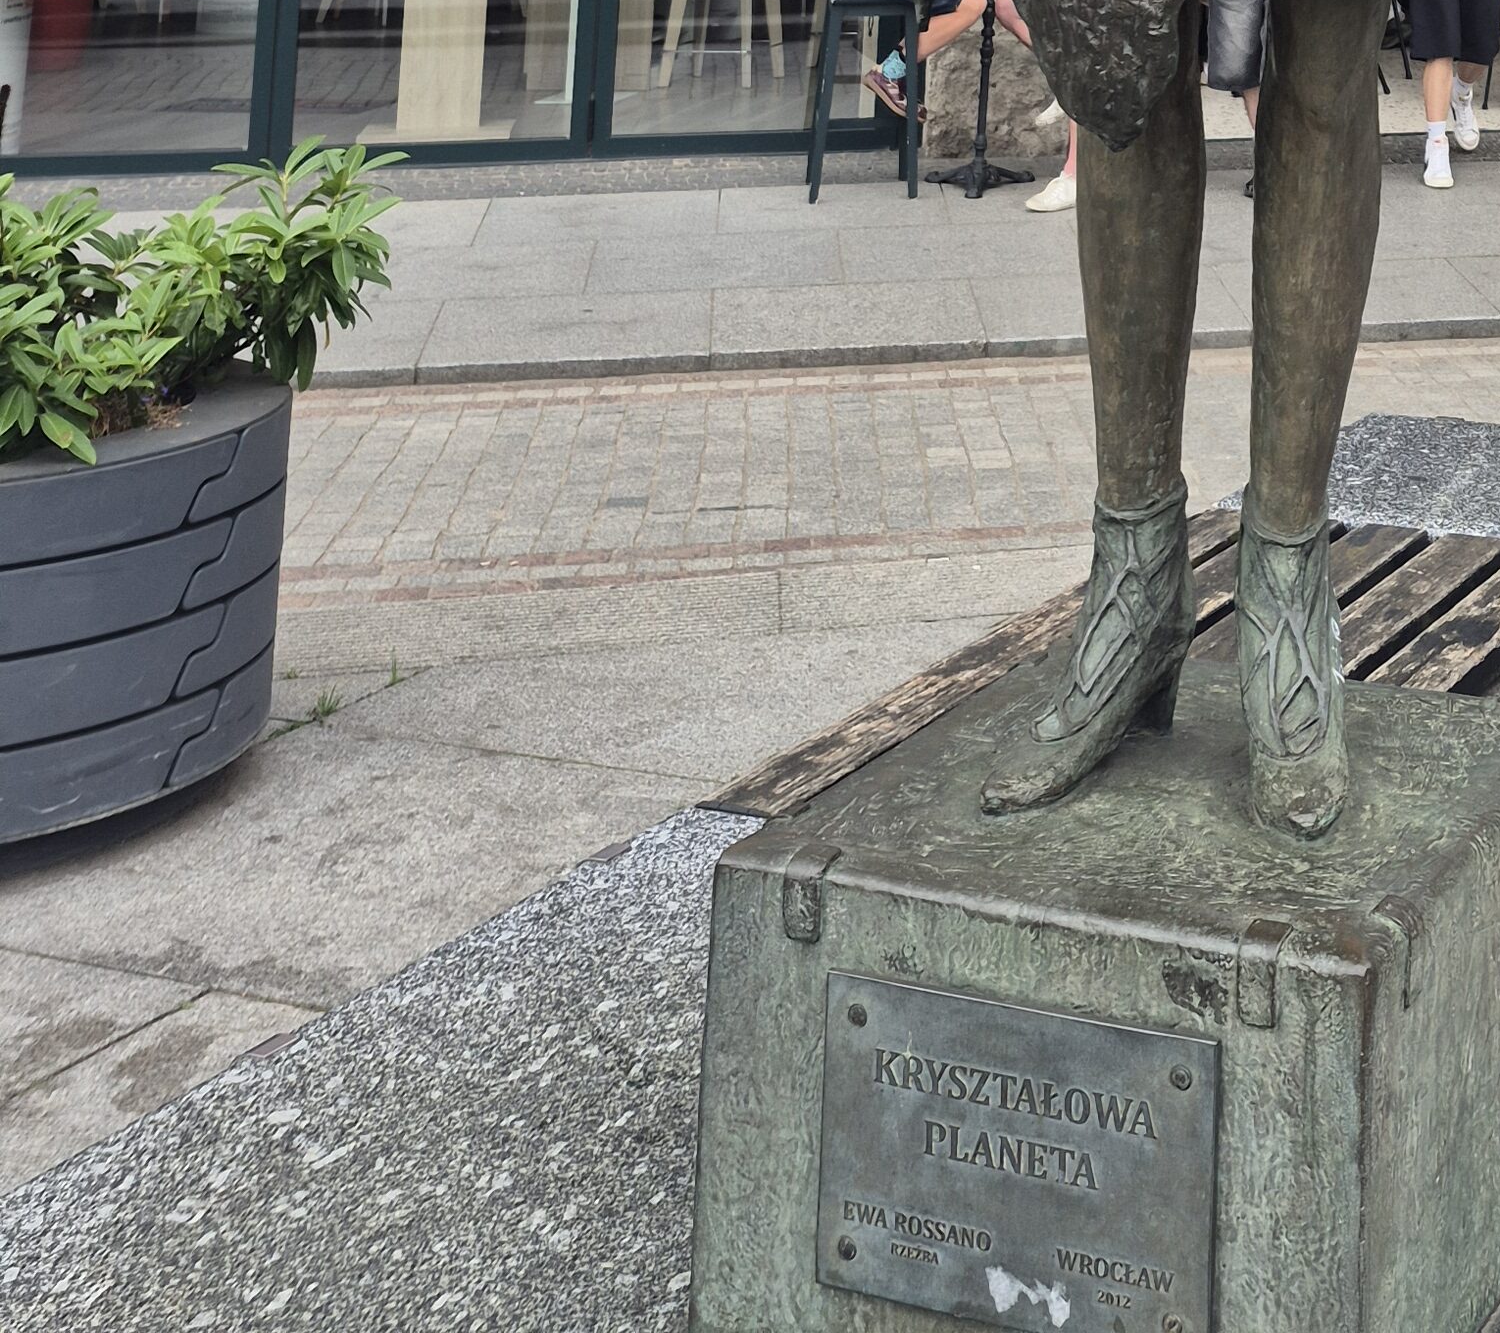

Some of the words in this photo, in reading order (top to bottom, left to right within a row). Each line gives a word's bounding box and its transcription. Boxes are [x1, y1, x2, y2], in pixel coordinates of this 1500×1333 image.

[873, 1047, 1158, 1140] KRYSZTAŁOWA
[923, 1120, 1100, 1192] PLANETA
[843, 1200, 890, 1230] EWA
[893, 1211, 993, 1253] ROSSANO
[1055, 1247, 1176, 1294] WROCŁAW
[1096, 1289, 1132, 1310] 2012
